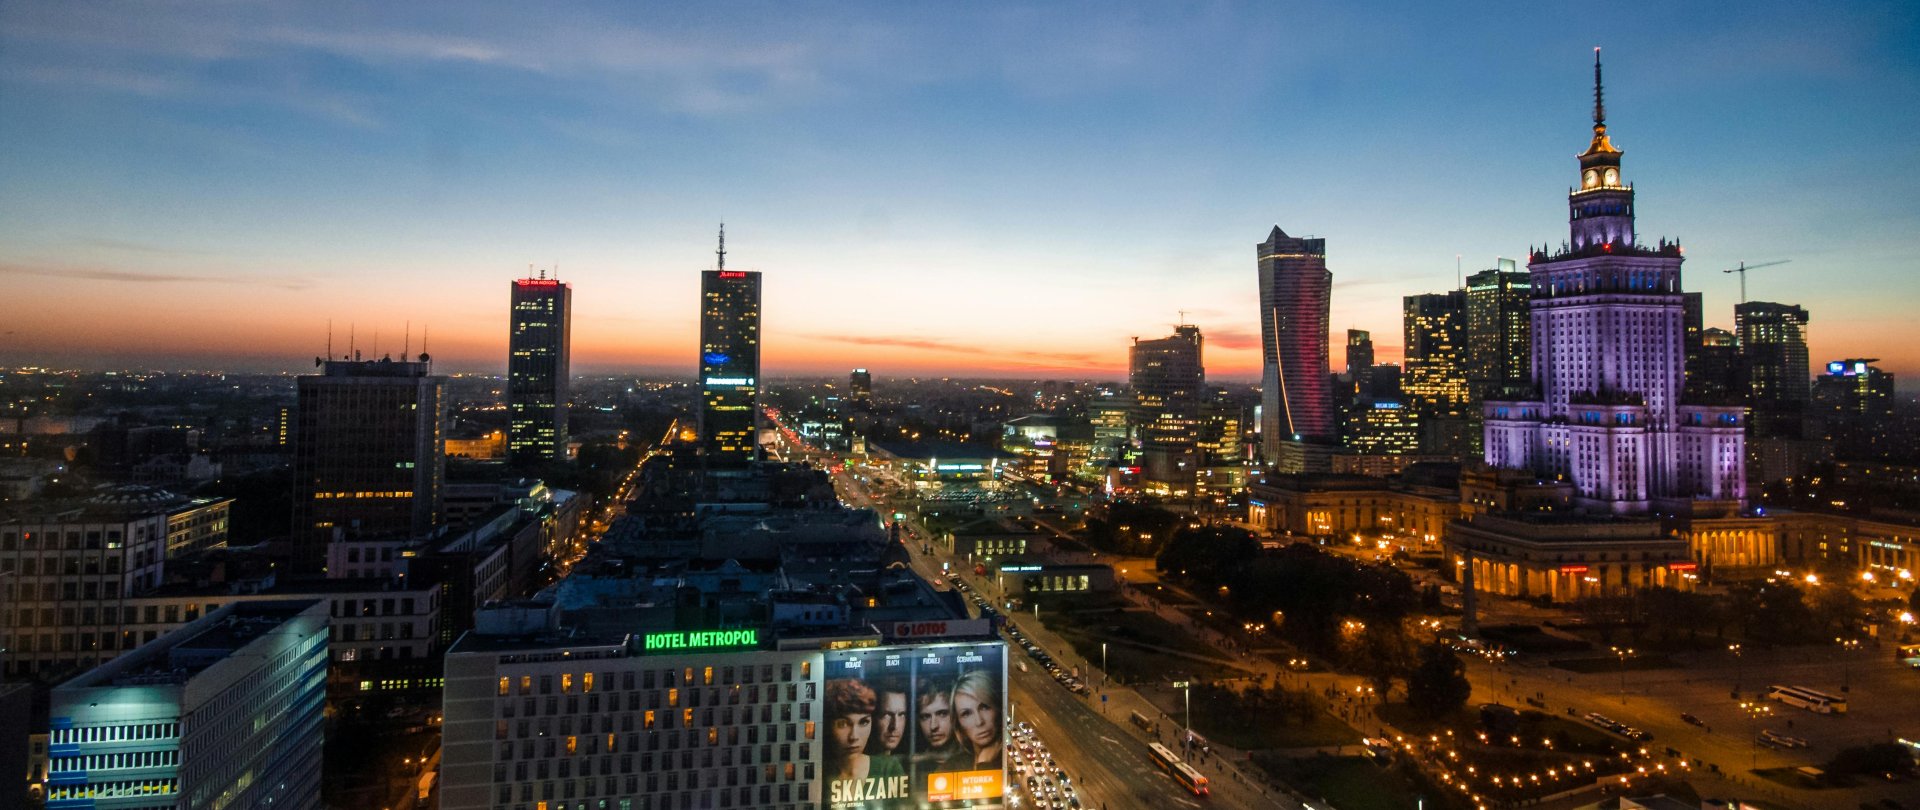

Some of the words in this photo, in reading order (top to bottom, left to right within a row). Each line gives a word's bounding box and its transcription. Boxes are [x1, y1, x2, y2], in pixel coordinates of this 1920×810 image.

[912, 623, 946, 635] LOTOS
[646, 633, 687, 649] HOTEL
[689, 630, 757, 647] METROPOL
[831, 776, 908, 802] SKAZANE
